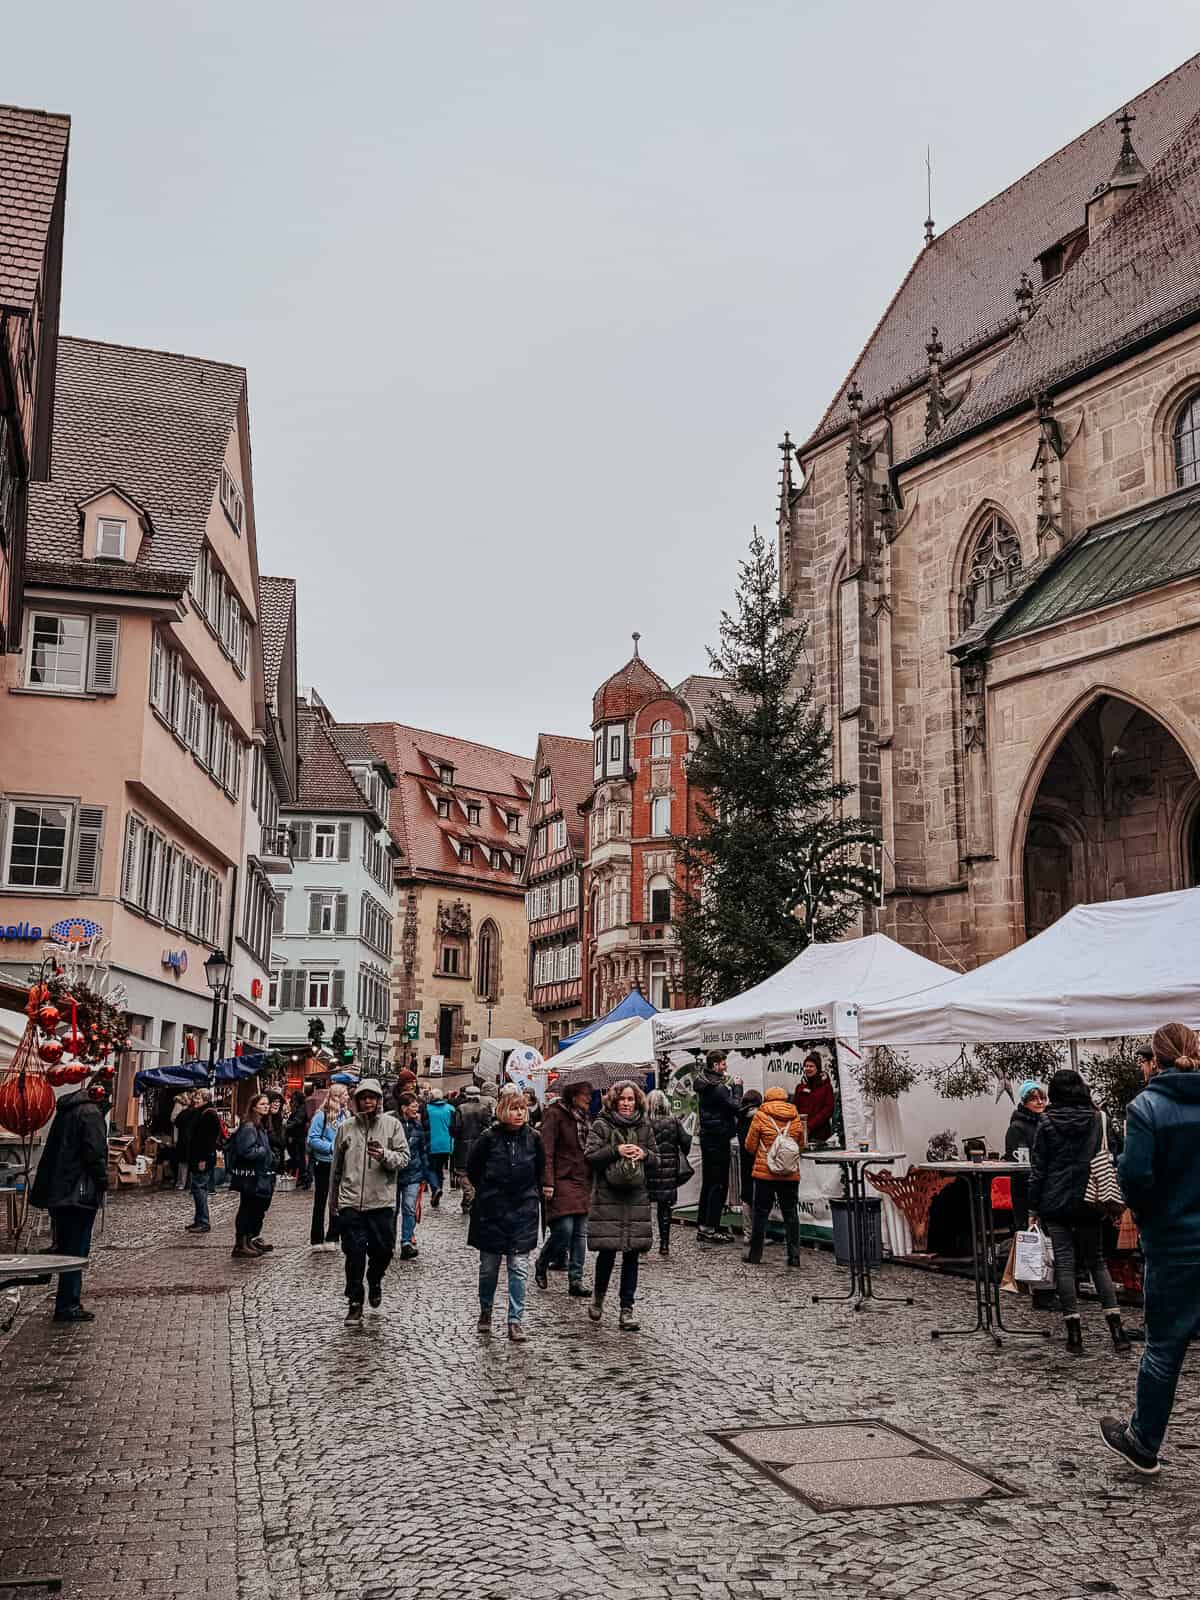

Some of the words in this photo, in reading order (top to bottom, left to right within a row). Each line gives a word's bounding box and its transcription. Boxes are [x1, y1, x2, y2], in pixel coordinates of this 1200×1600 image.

[703, 1032, 720, 1043] Jedes
[721, 1031, 733, 1042] Los
[735, 1029, 763, 1044] gewinnt!
